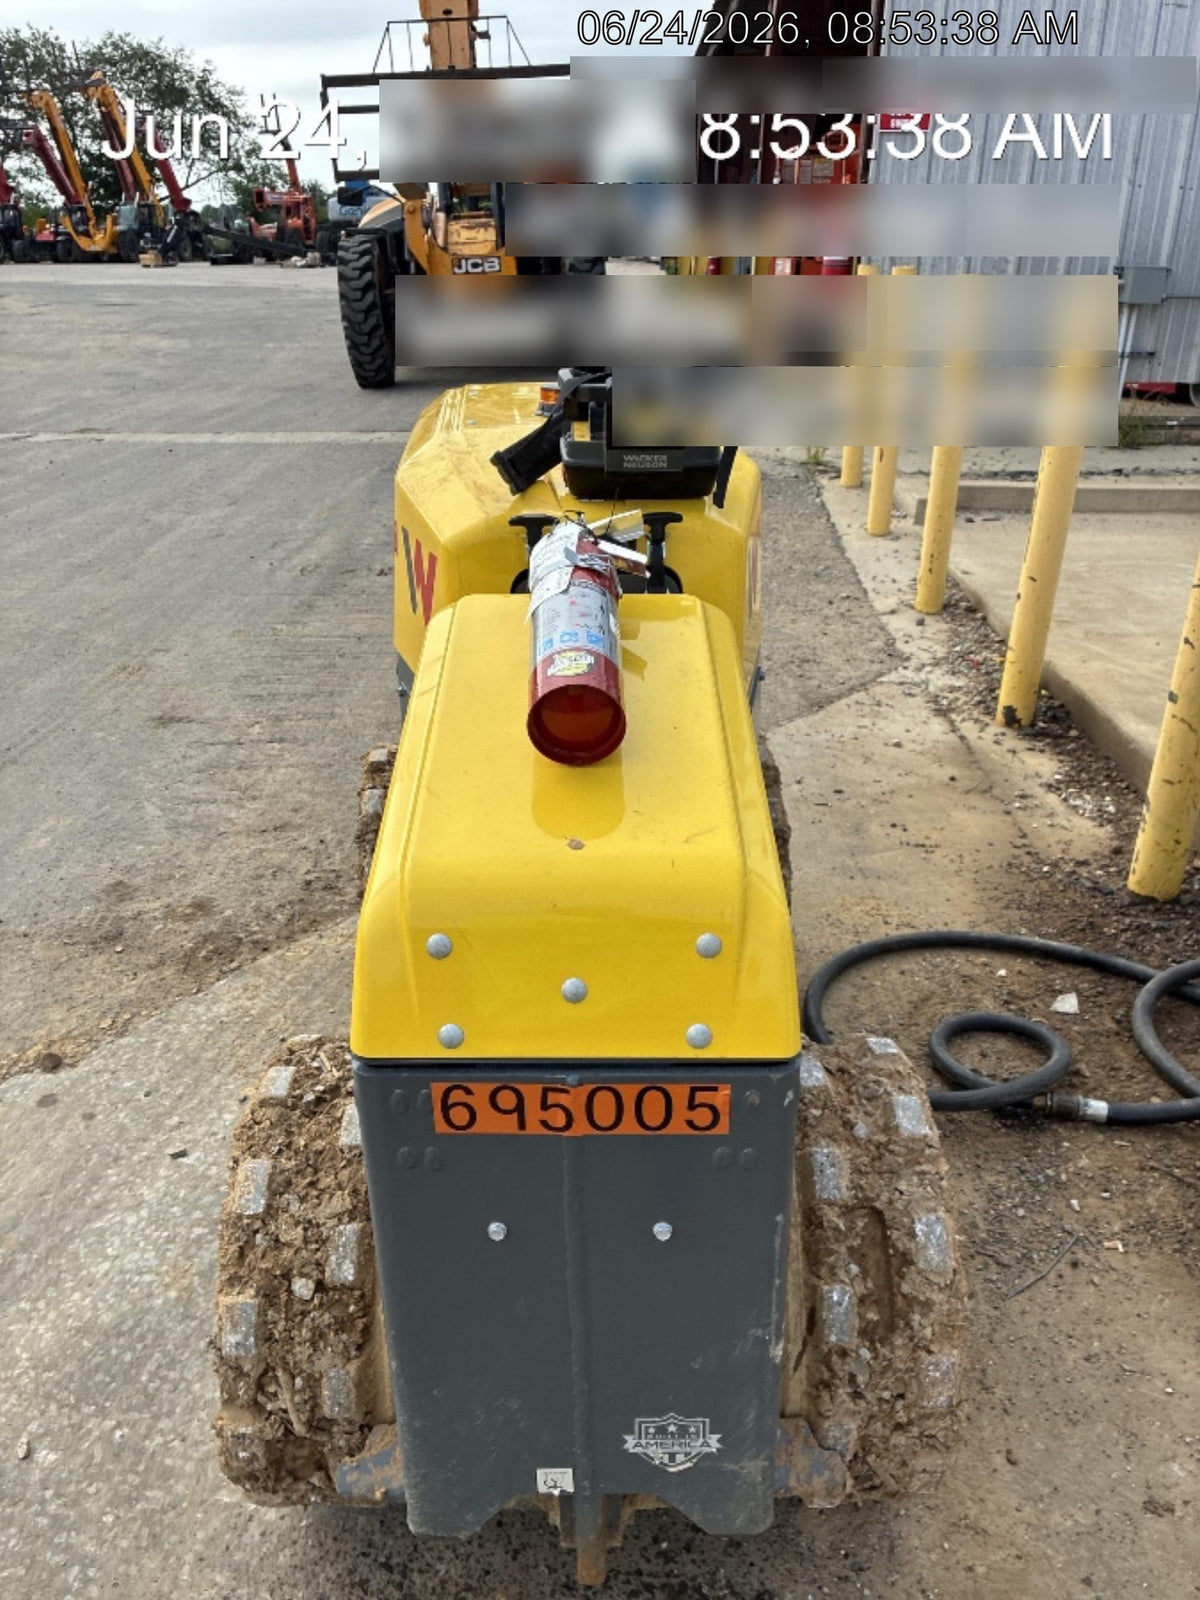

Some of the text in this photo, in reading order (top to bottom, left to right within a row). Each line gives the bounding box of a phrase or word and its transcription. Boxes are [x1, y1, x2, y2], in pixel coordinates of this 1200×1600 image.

[454, 257, 500, 273] JCB
[623, 461, 668, 469] NEUSON
[440, 1084, 721, 1132] 695005
[632, 1440, 713, 1450] AMERICA
